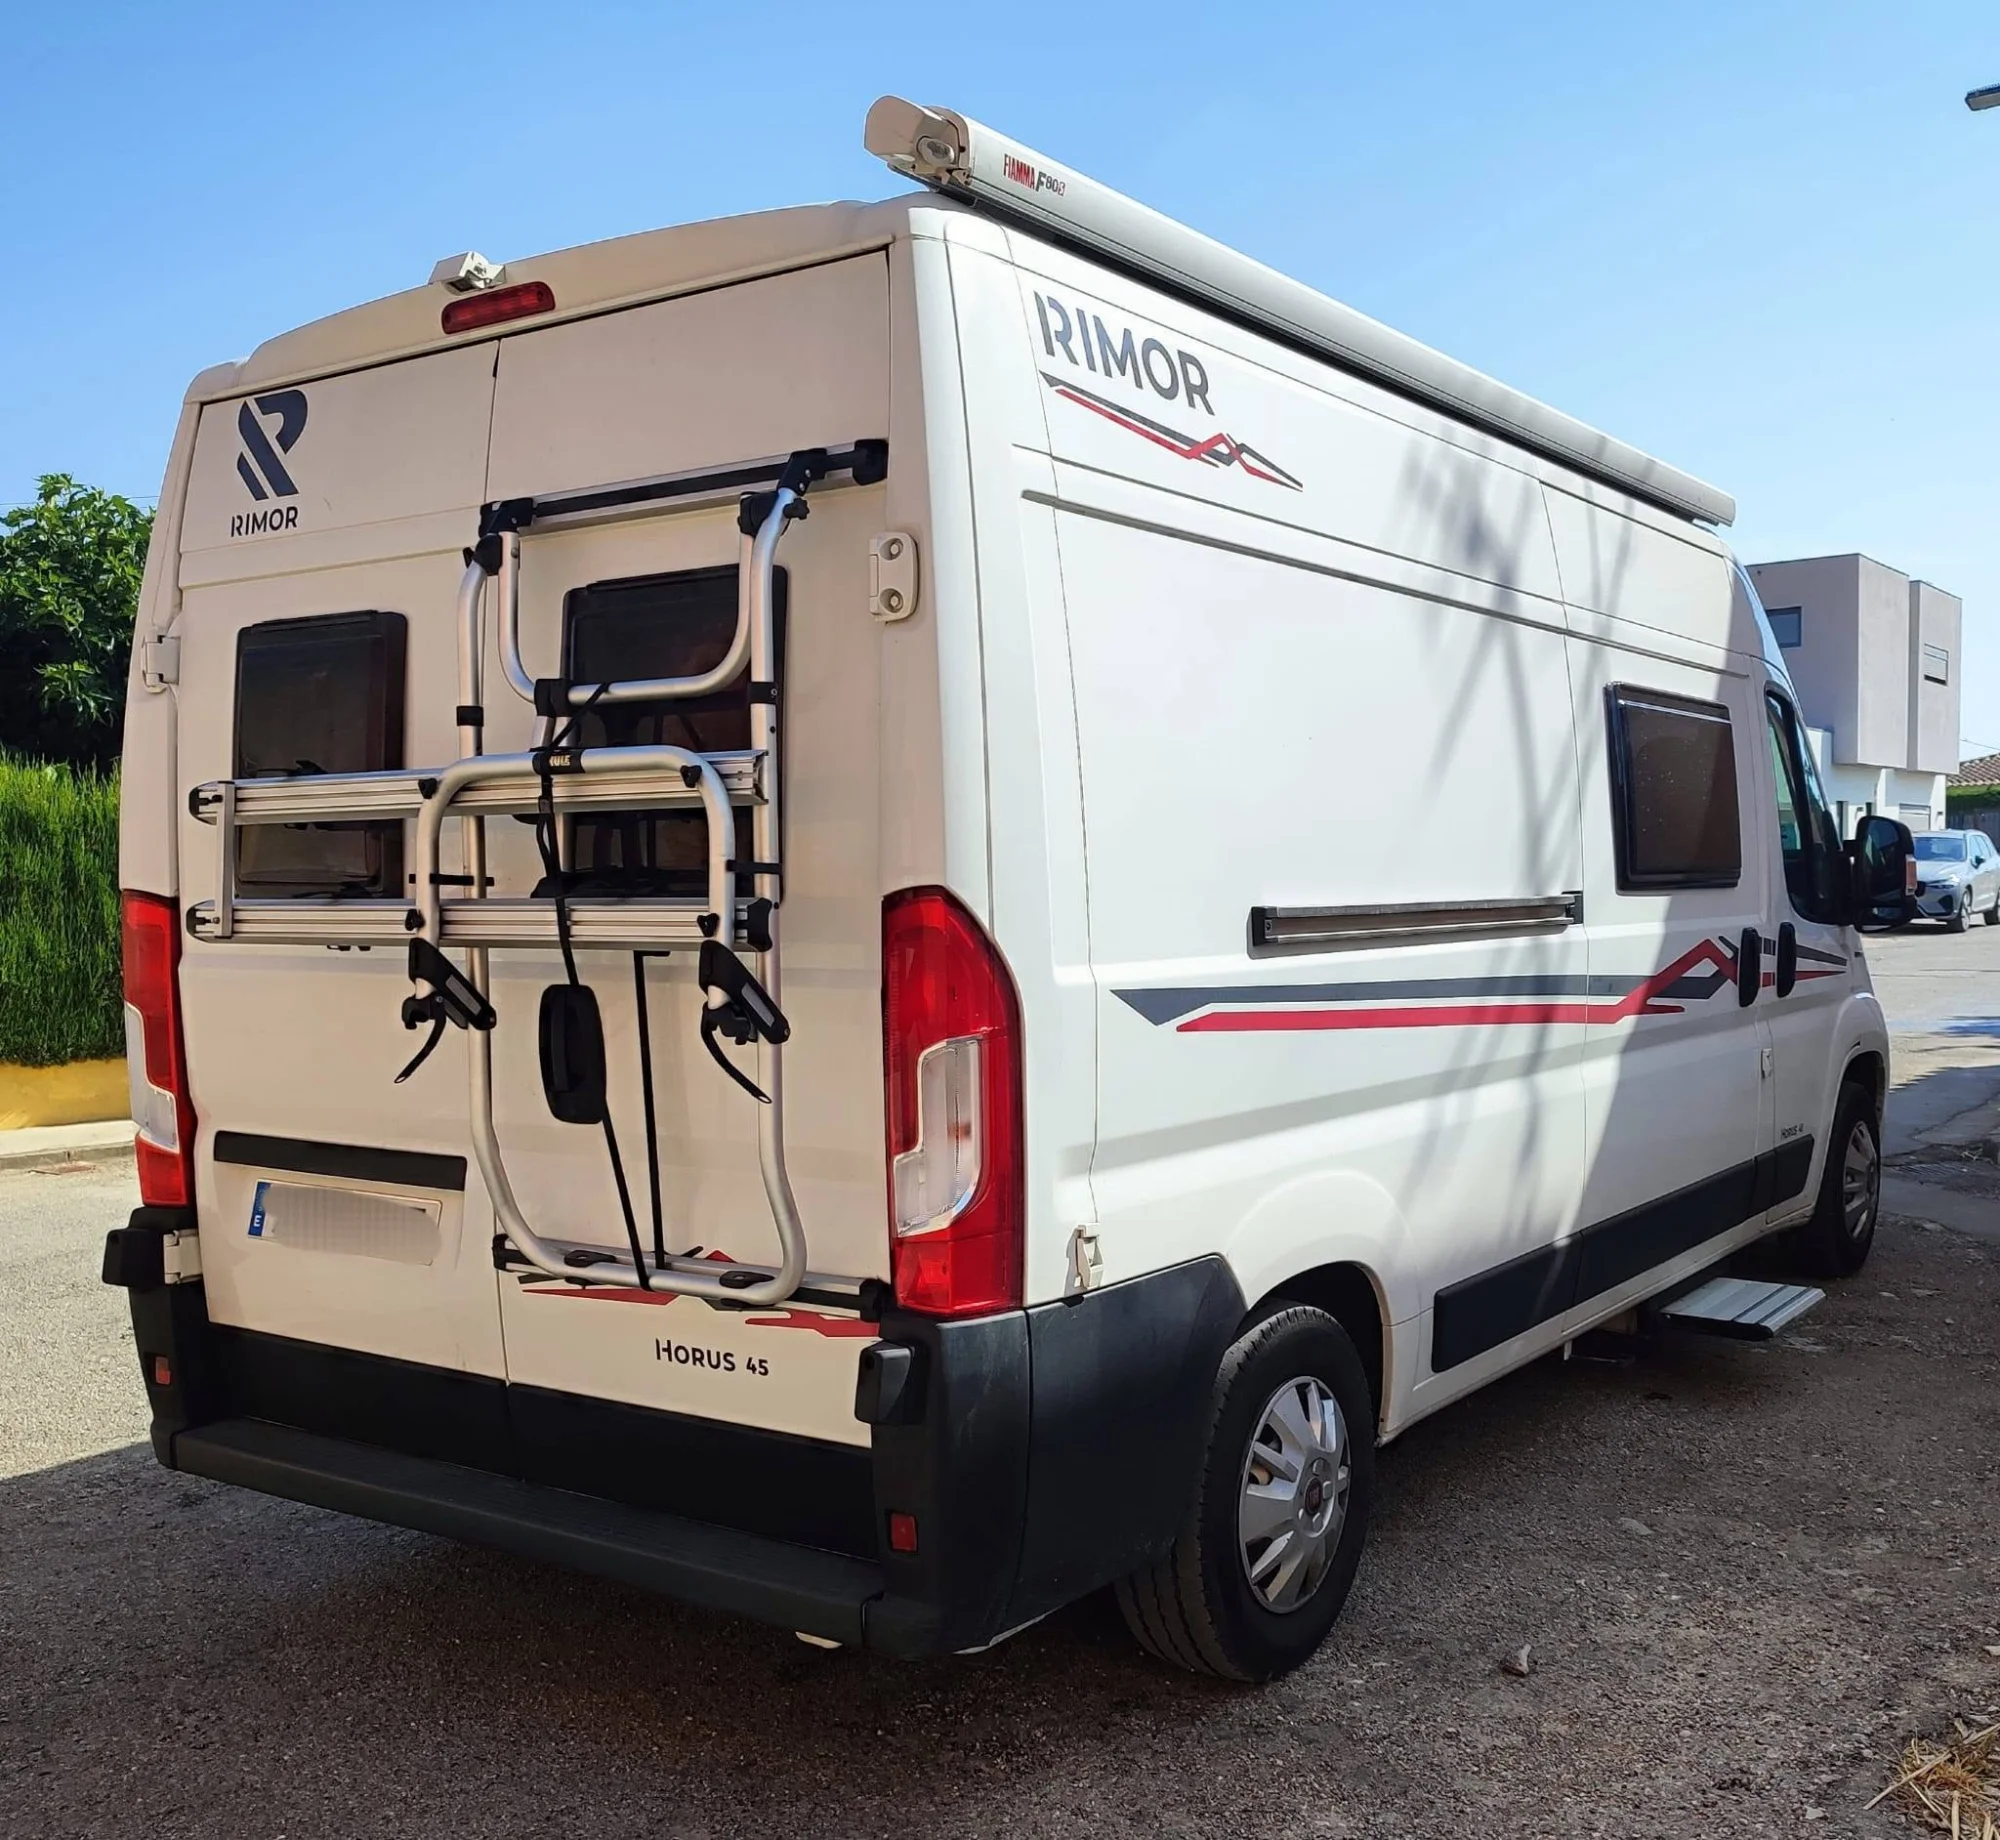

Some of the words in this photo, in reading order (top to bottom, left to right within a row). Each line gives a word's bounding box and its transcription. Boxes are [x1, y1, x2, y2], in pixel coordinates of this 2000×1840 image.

[1003, 153, 1035, 190] FIAMMA
[1033, 290, 1216, 416] RIMOR
[230, 506, 299, 538] RIMOR
[655, 1338, 736, 1372] HORUS
[746, 1356, 769, 1376] 45
